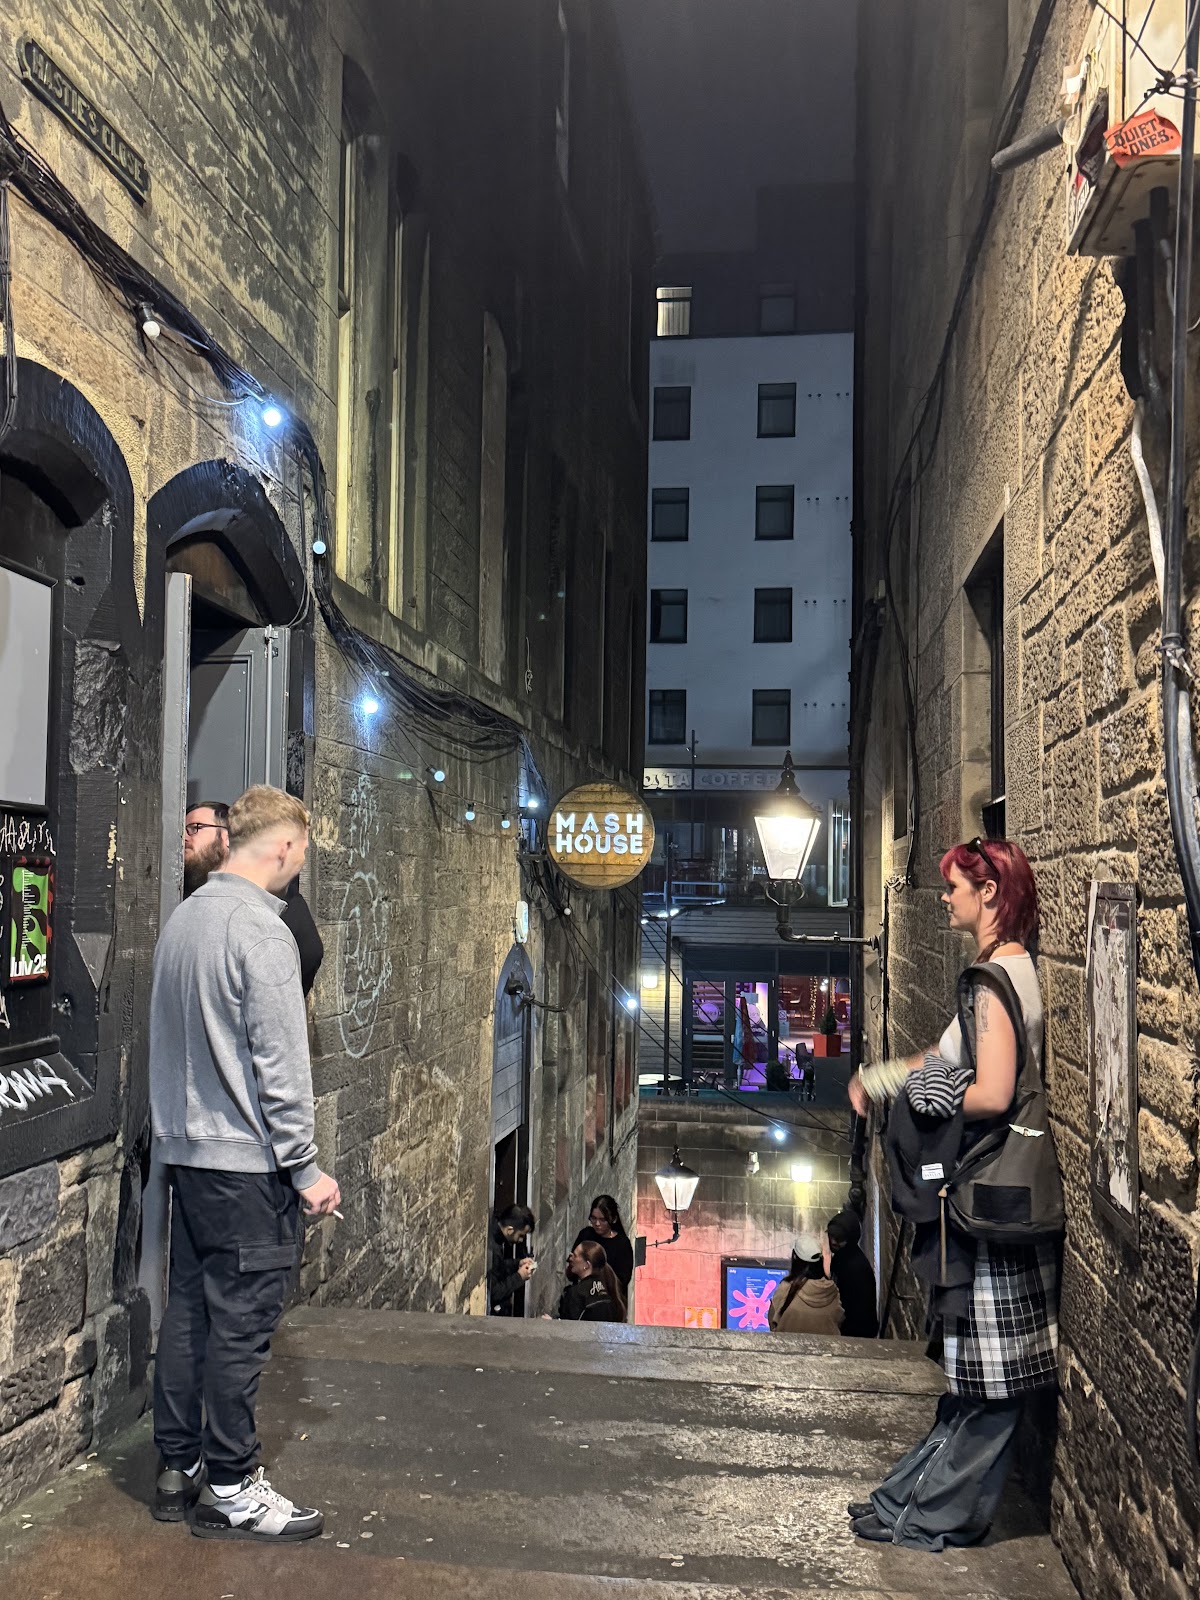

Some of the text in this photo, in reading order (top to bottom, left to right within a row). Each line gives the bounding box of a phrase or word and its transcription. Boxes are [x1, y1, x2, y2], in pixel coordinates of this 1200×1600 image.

[32, 47, 143, 186] HASTIE'S CLOSE
[1113, 117, 1158, 149] QUIET
[556, 812, 643, 834] MASH
[556, 833, 643, 854] HOUSE
